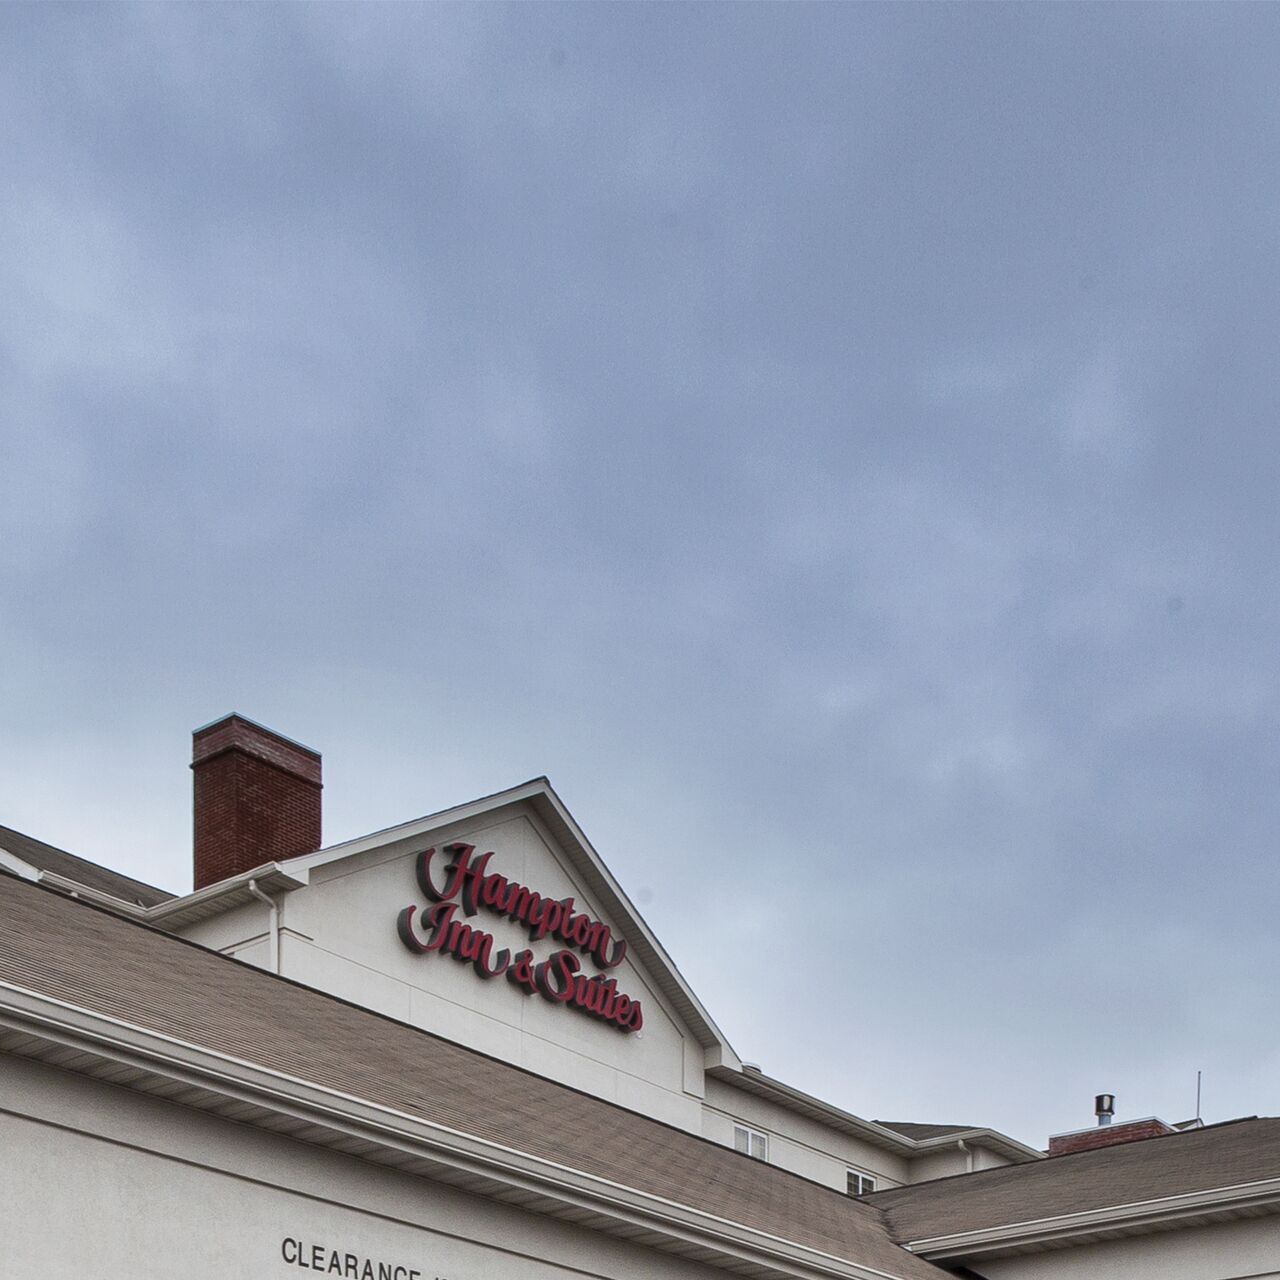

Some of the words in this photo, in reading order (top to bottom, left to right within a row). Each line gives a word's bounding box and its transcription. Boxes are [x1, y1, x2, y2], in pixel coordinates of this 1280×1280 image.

[397, 902, 510, 979] Inn
[506, 949, 539, 994] &
[535, 950, 643, 1033] Suites
[416, 842, 627, 969] Hampton
